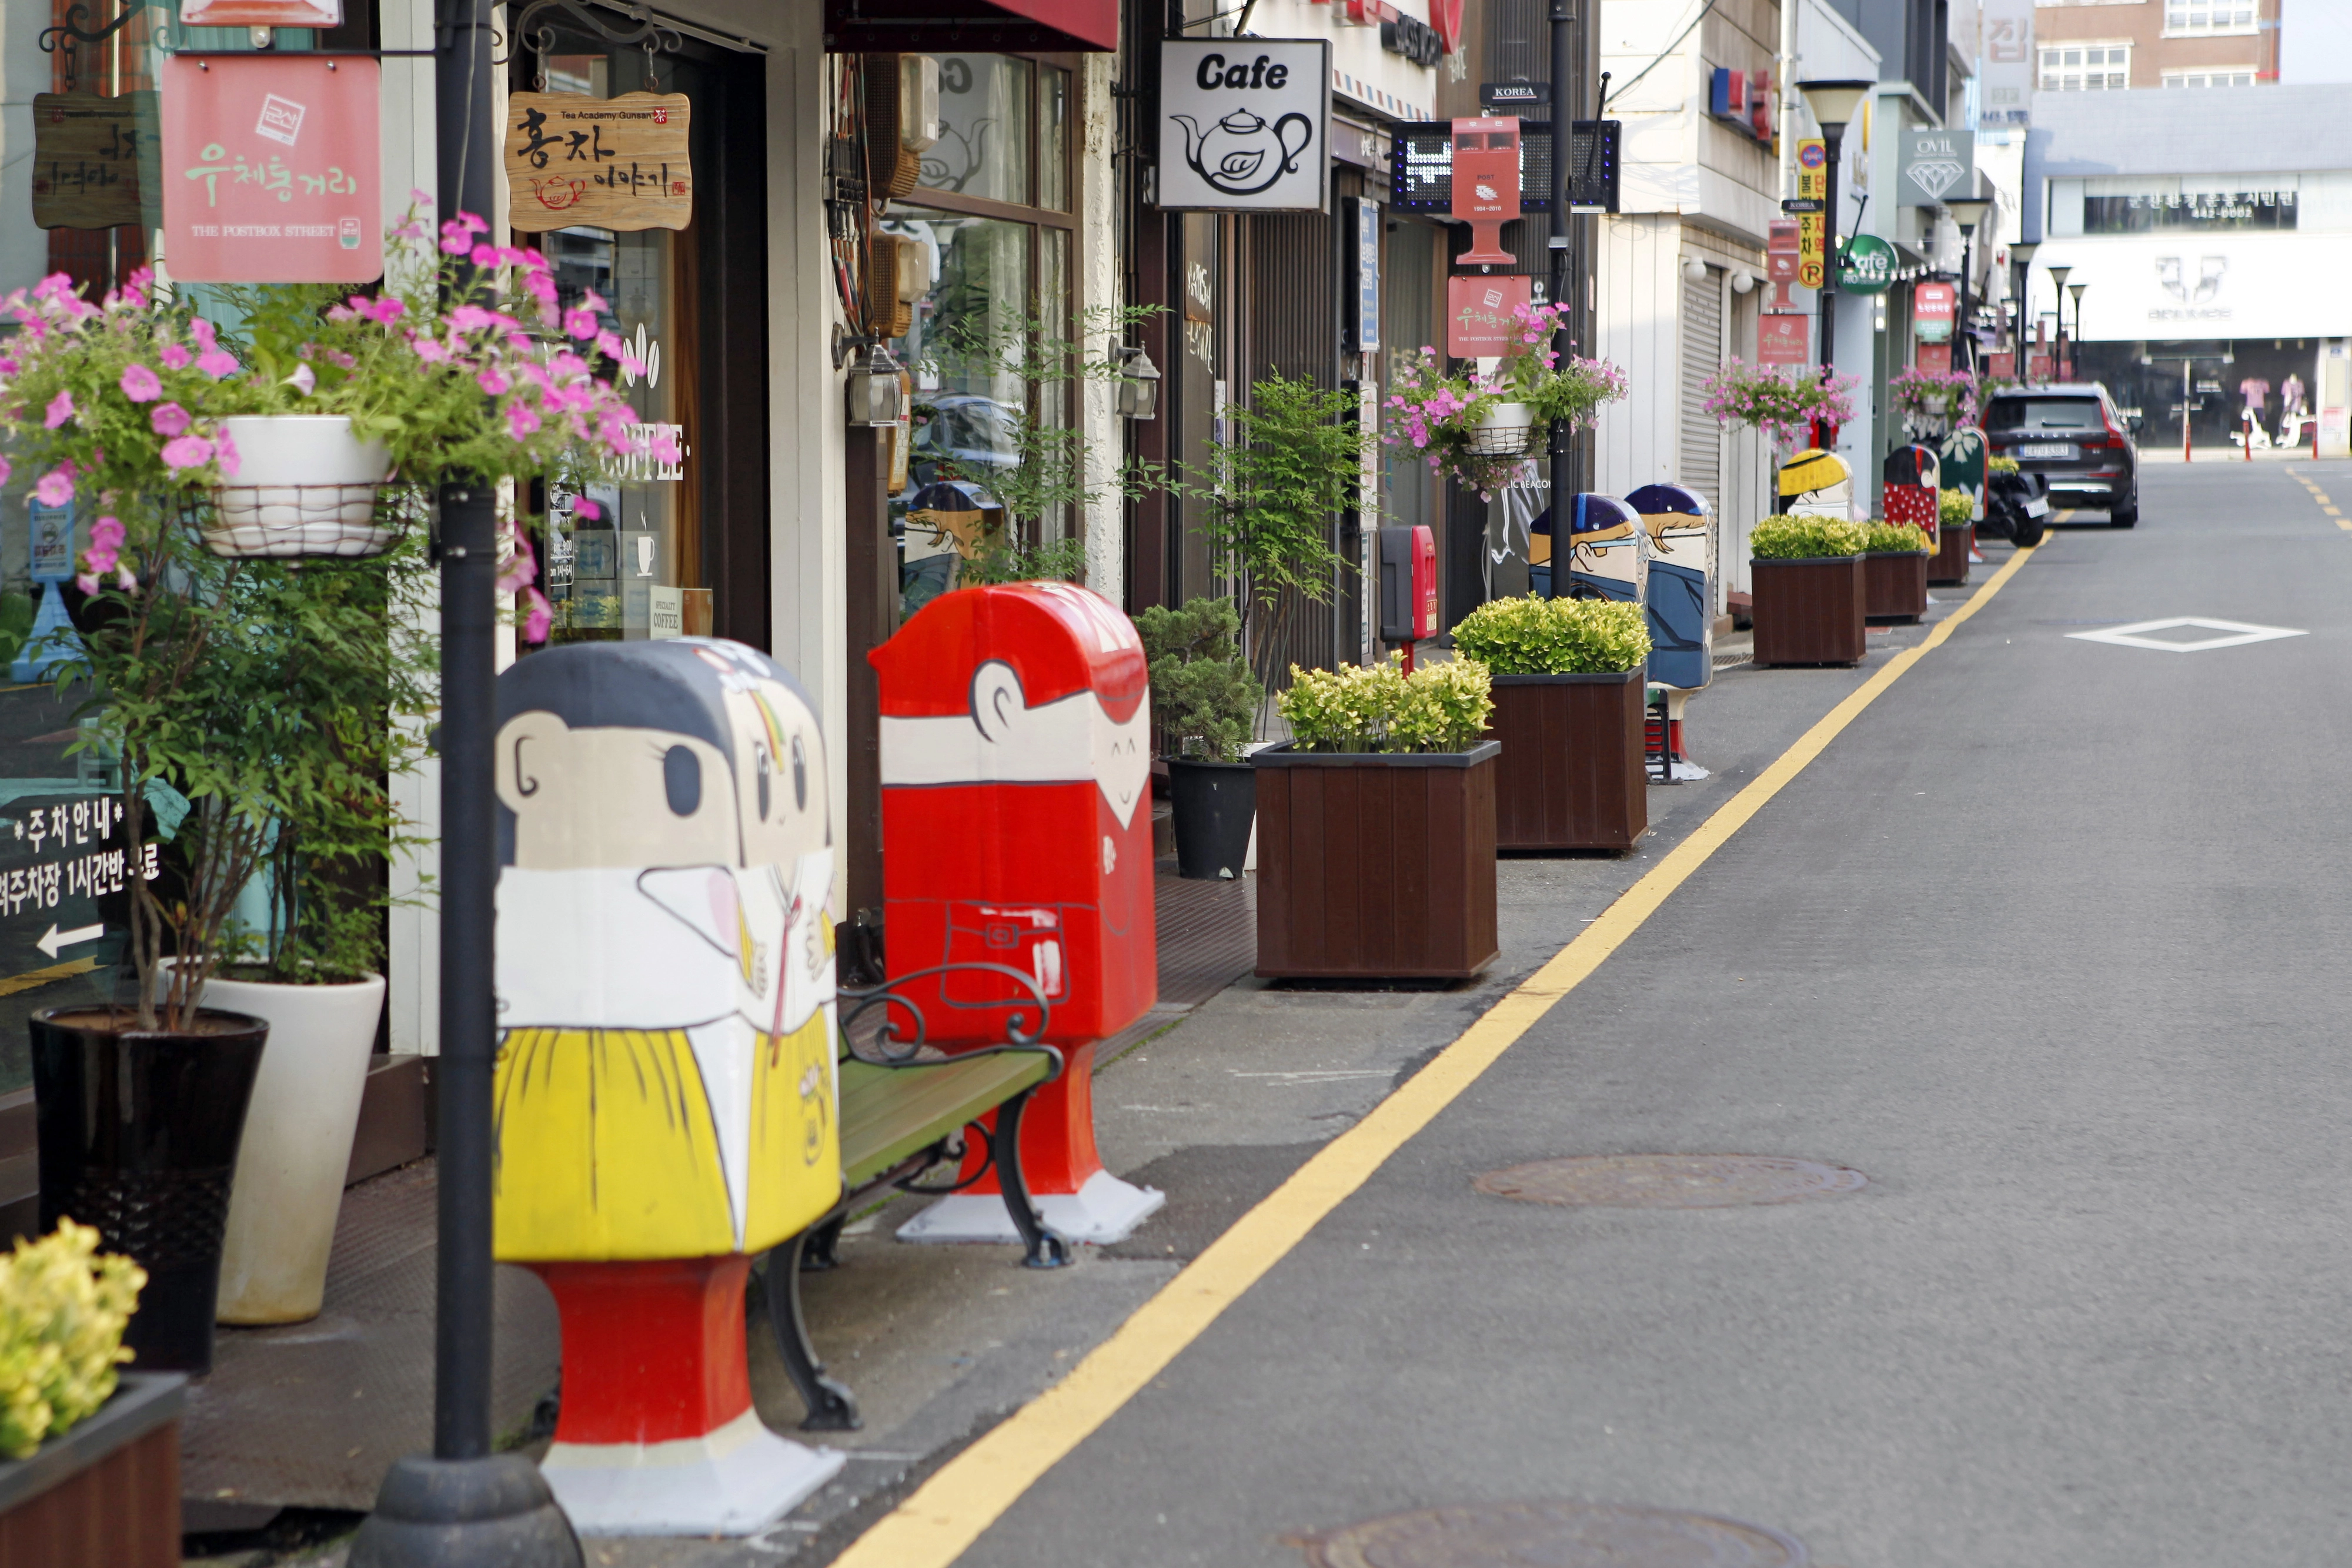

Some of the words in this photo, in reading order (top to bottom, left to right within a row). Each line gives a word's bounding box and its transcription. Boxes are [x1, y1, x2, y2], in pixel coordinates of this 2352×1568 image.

[1196, 54, 1289, 90] Cafe
[1495, 88, 1534, 96] KOREA
[561, 111, 576, 119] Tea
[578, 111, 617, 121] Academy
[619, 111, 652, 119] Gunsan
[517, 108, 616, 169] 홍차
[1916, 137, 1956, 153] OVIL
[594, 162, 668, 198] 이야기
[192, 226, 219, 236] THE
[223, 226, 282, 236] POSTBOX
[285, 226, 336, 236] STREET
[1848, 249, 1889, 270] afe
[656, 600, 676, 611] SPECIALTY
[653, 612, 678, 630] COFFEE
[66, 849, 125, 898] 1시간반
